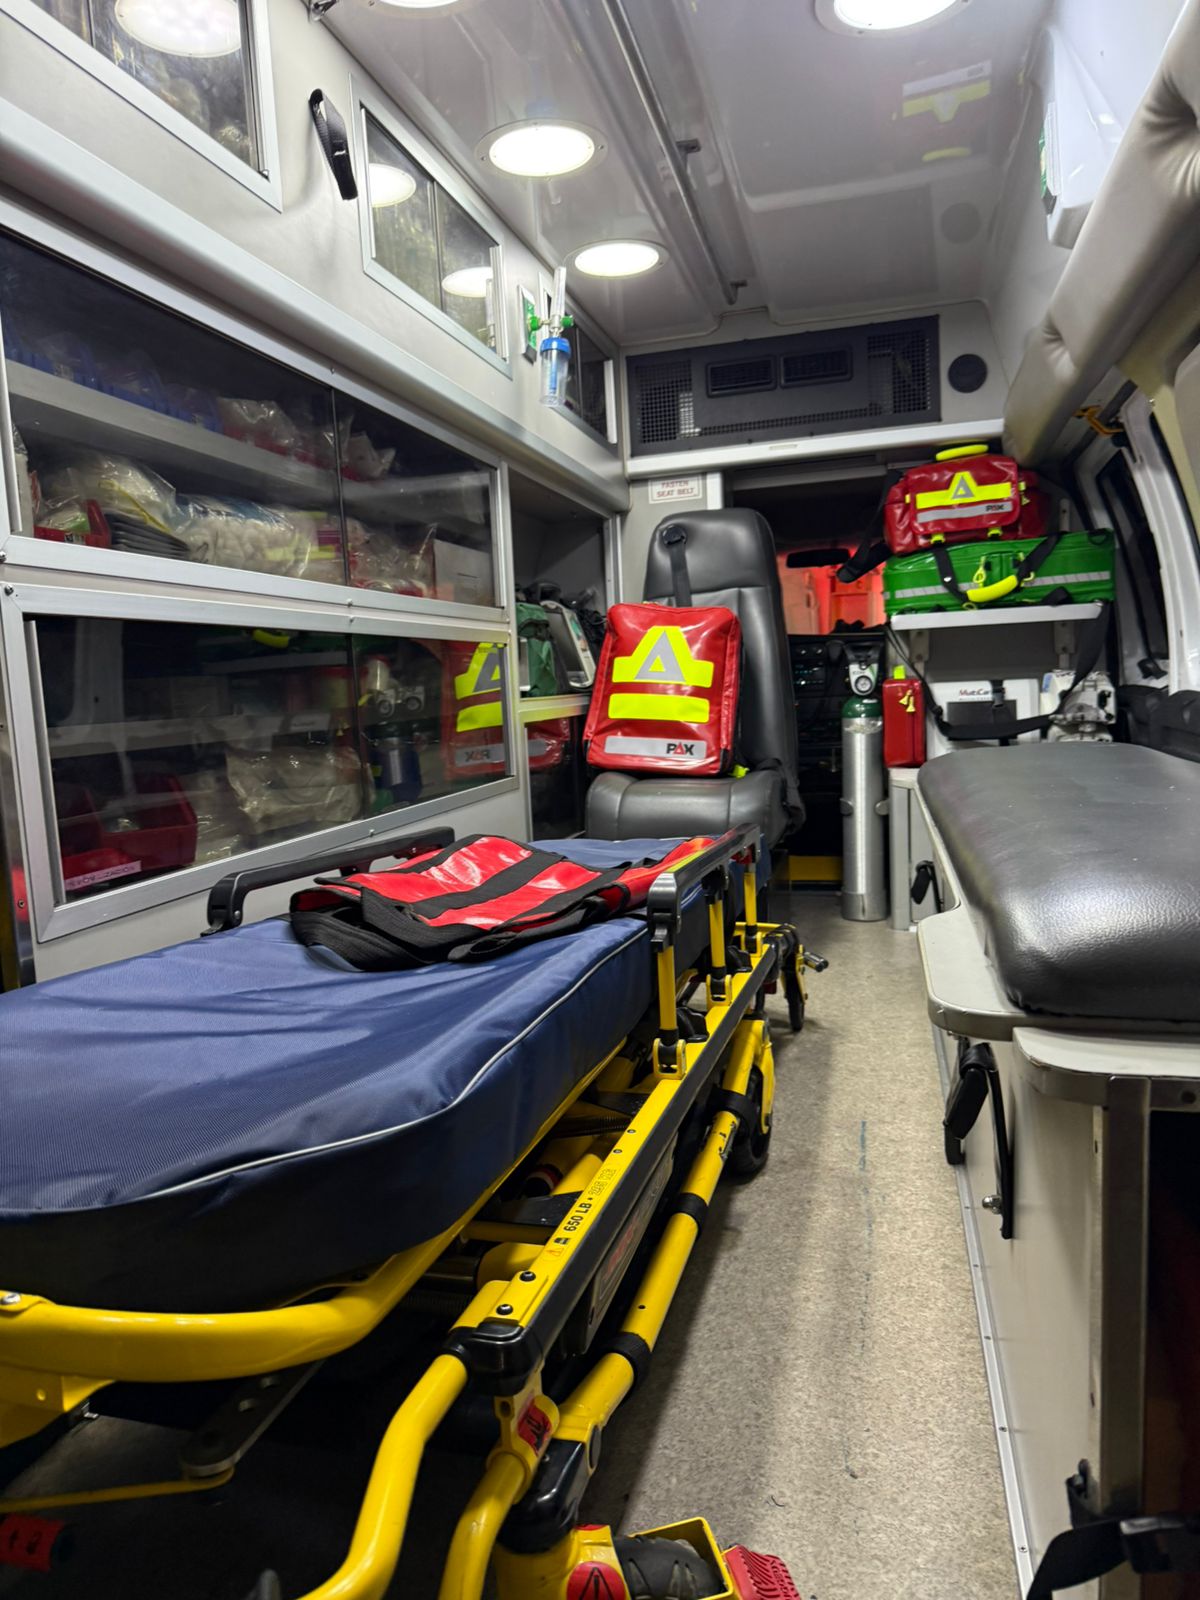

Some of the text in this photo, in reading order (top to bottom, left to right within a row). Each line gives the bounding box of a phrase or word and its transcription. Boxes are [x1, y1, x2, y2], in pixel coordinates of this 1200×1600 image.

[656, 488, 694, 498] SEAT BELT
[985, 504, 1004, 512] PAX
[667, 741, 695, 756] PAX
[563, 1202, 592, 1232] 650 LB
